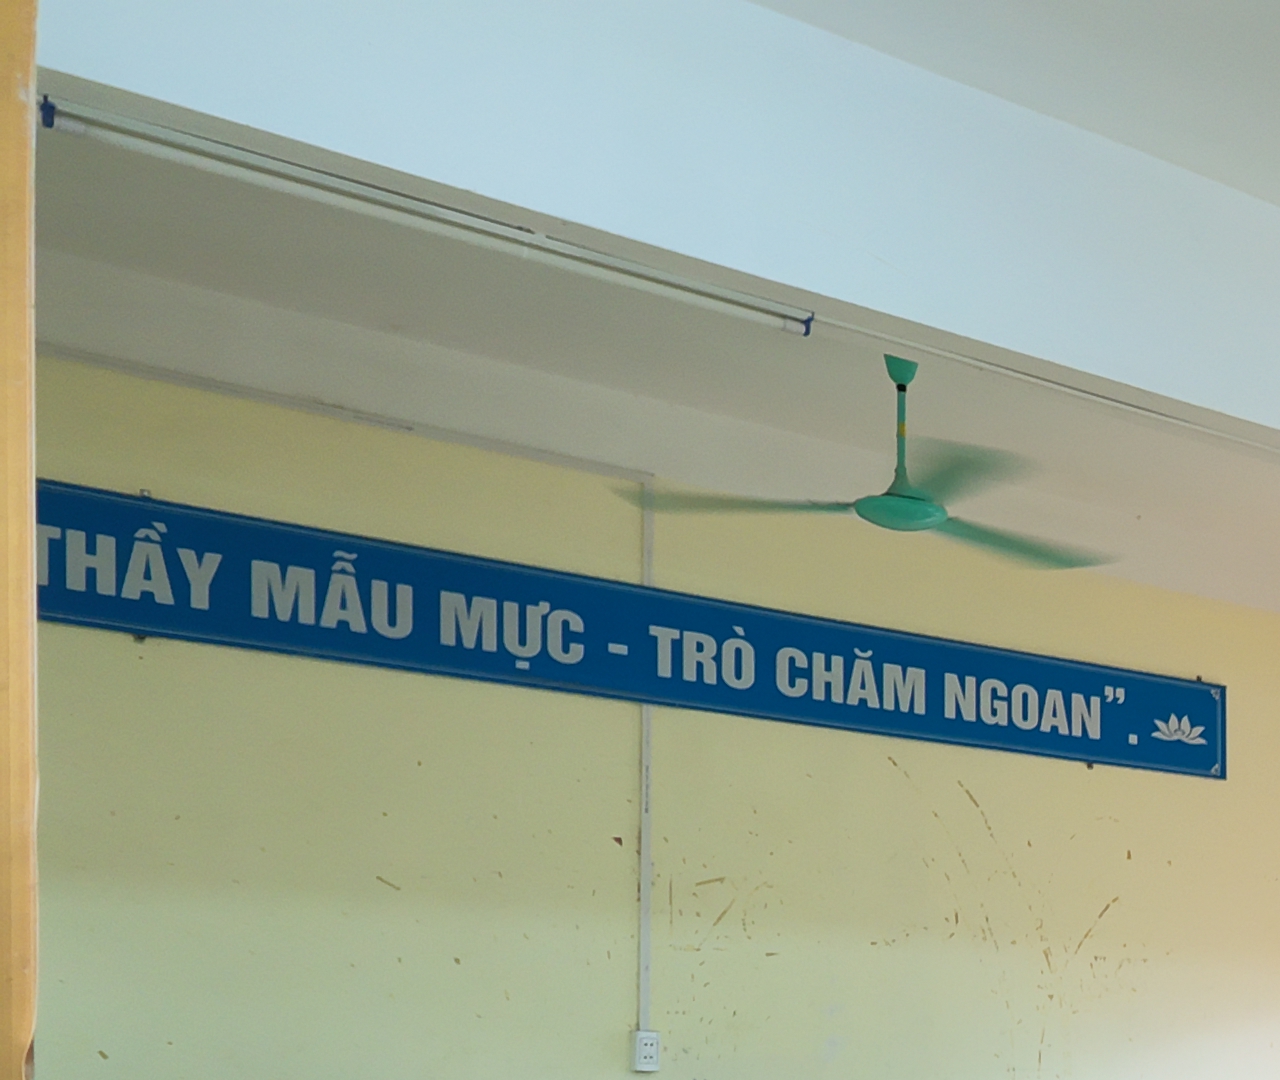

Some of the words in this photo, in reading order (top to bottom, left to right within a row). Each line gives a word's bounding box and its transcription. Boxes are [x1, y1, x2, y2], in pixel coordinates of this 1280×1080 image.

[251, 551, 413, 639] MẪU
[440, 591, 585, 671] MỰC
[649, 625, 756, 690] TRÒ
[776, 647, 926, 715] CHĂM
